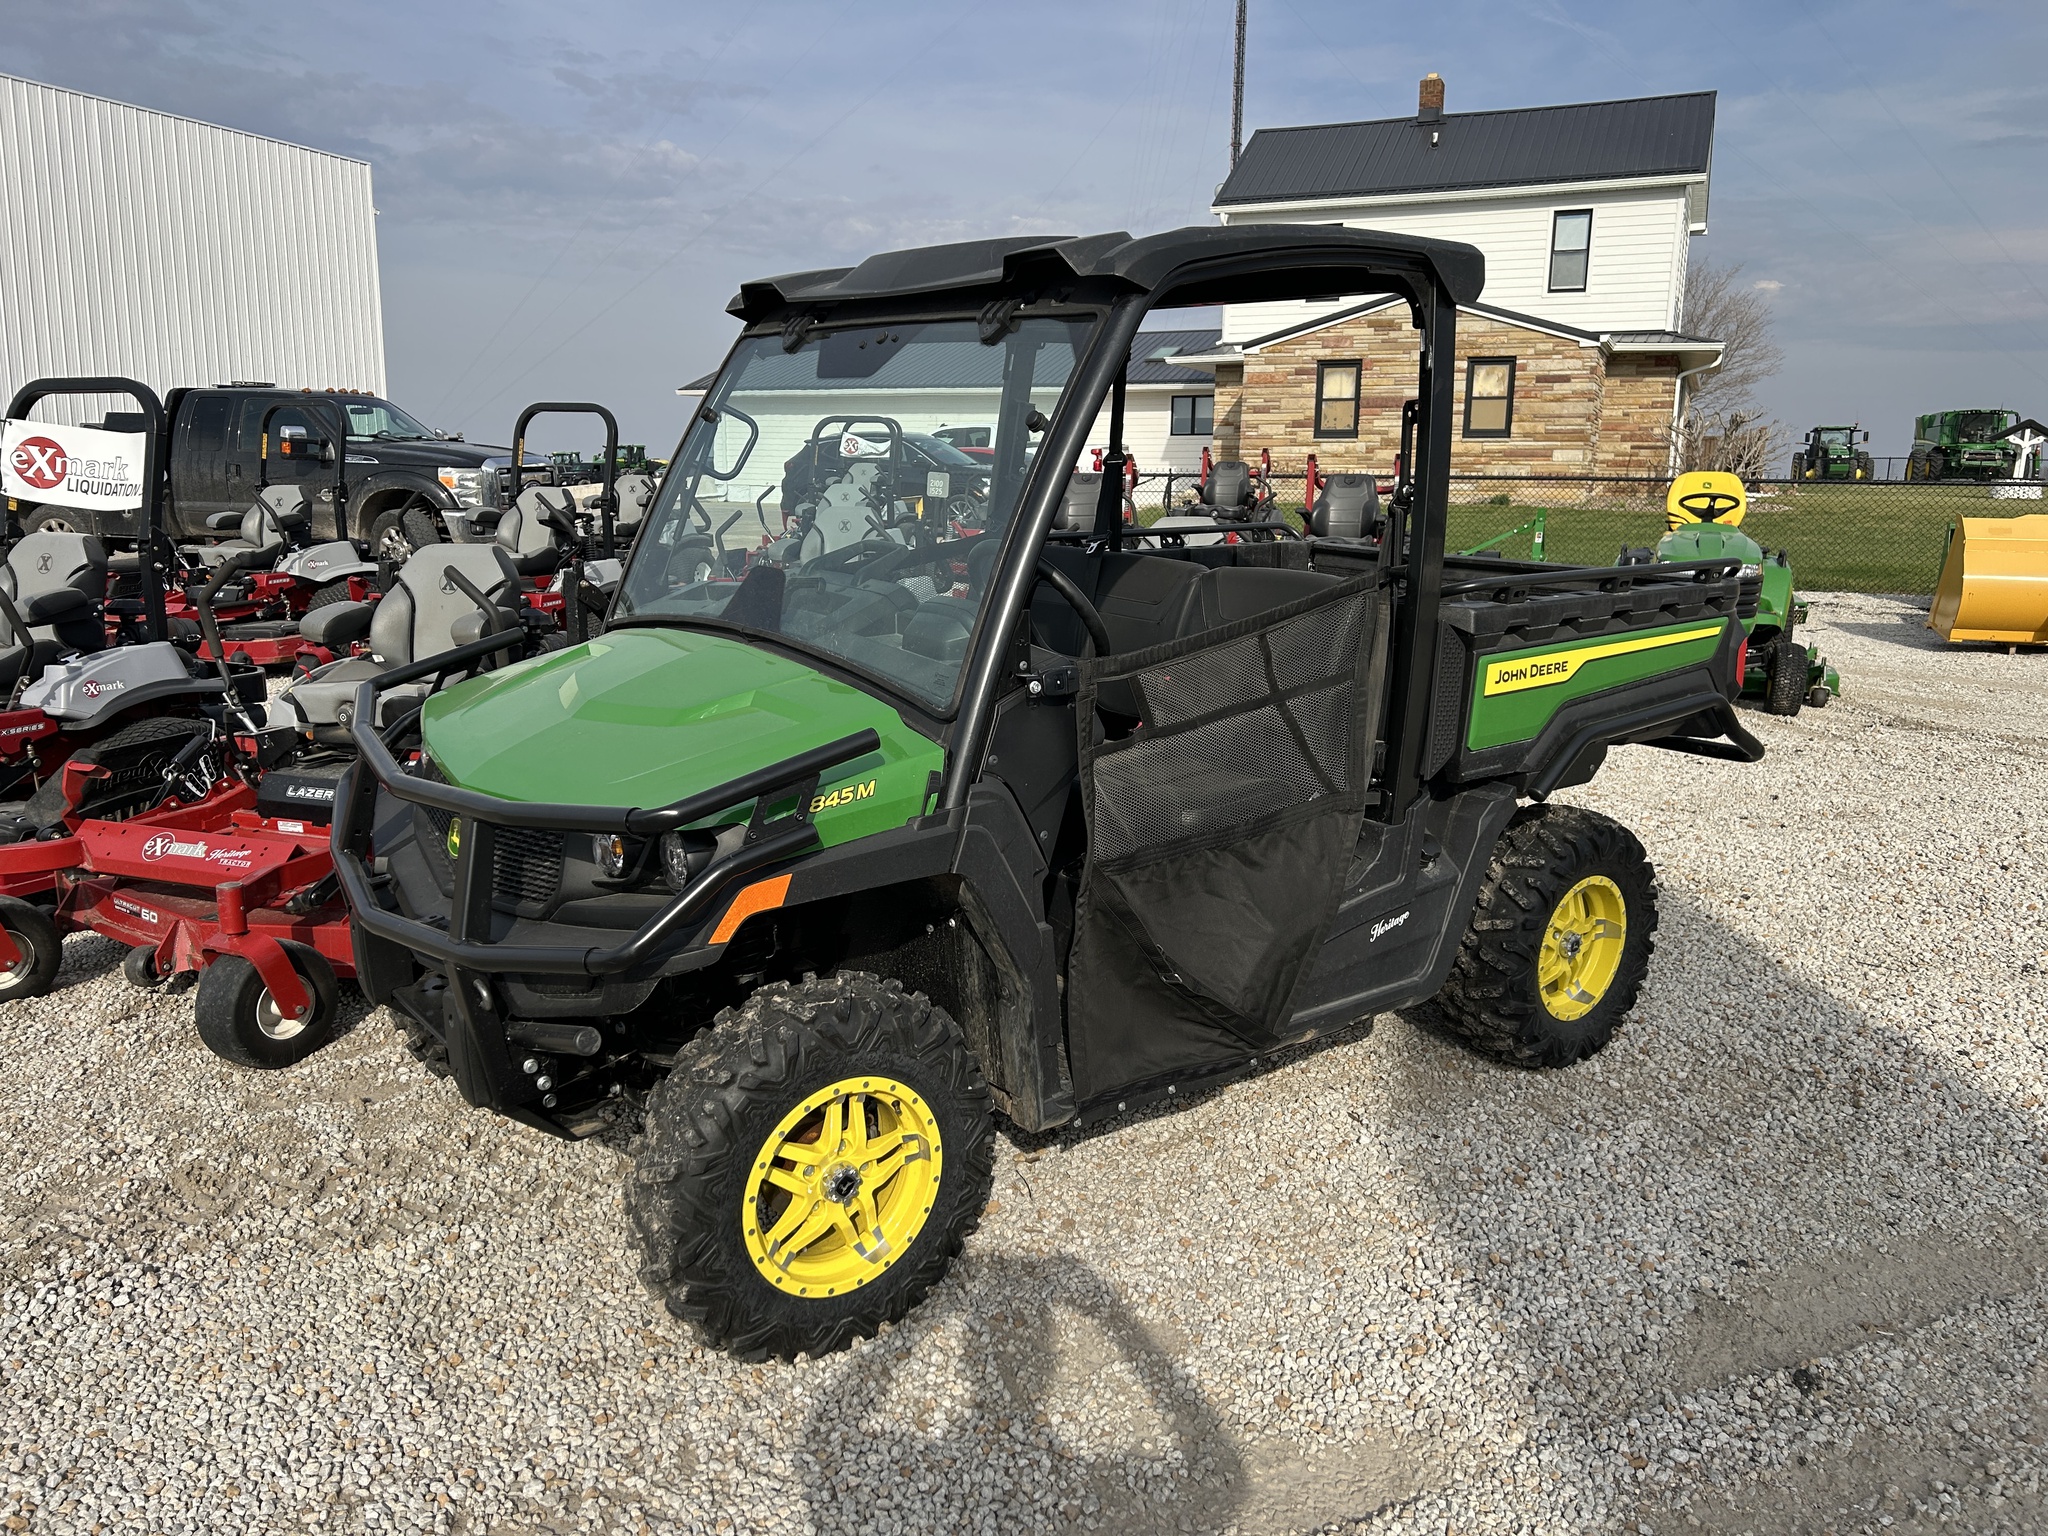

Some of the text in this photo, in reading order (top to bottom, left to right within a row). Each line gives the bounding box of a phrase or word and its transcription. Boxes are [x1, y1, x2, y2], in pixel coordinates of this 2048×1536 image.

[929, 487, 943, 496] 1525
[286, 785, 335, 801] LAZER
[141, 907, 158, 923] 60
[1370, 910, 1410, 942] Heritage
